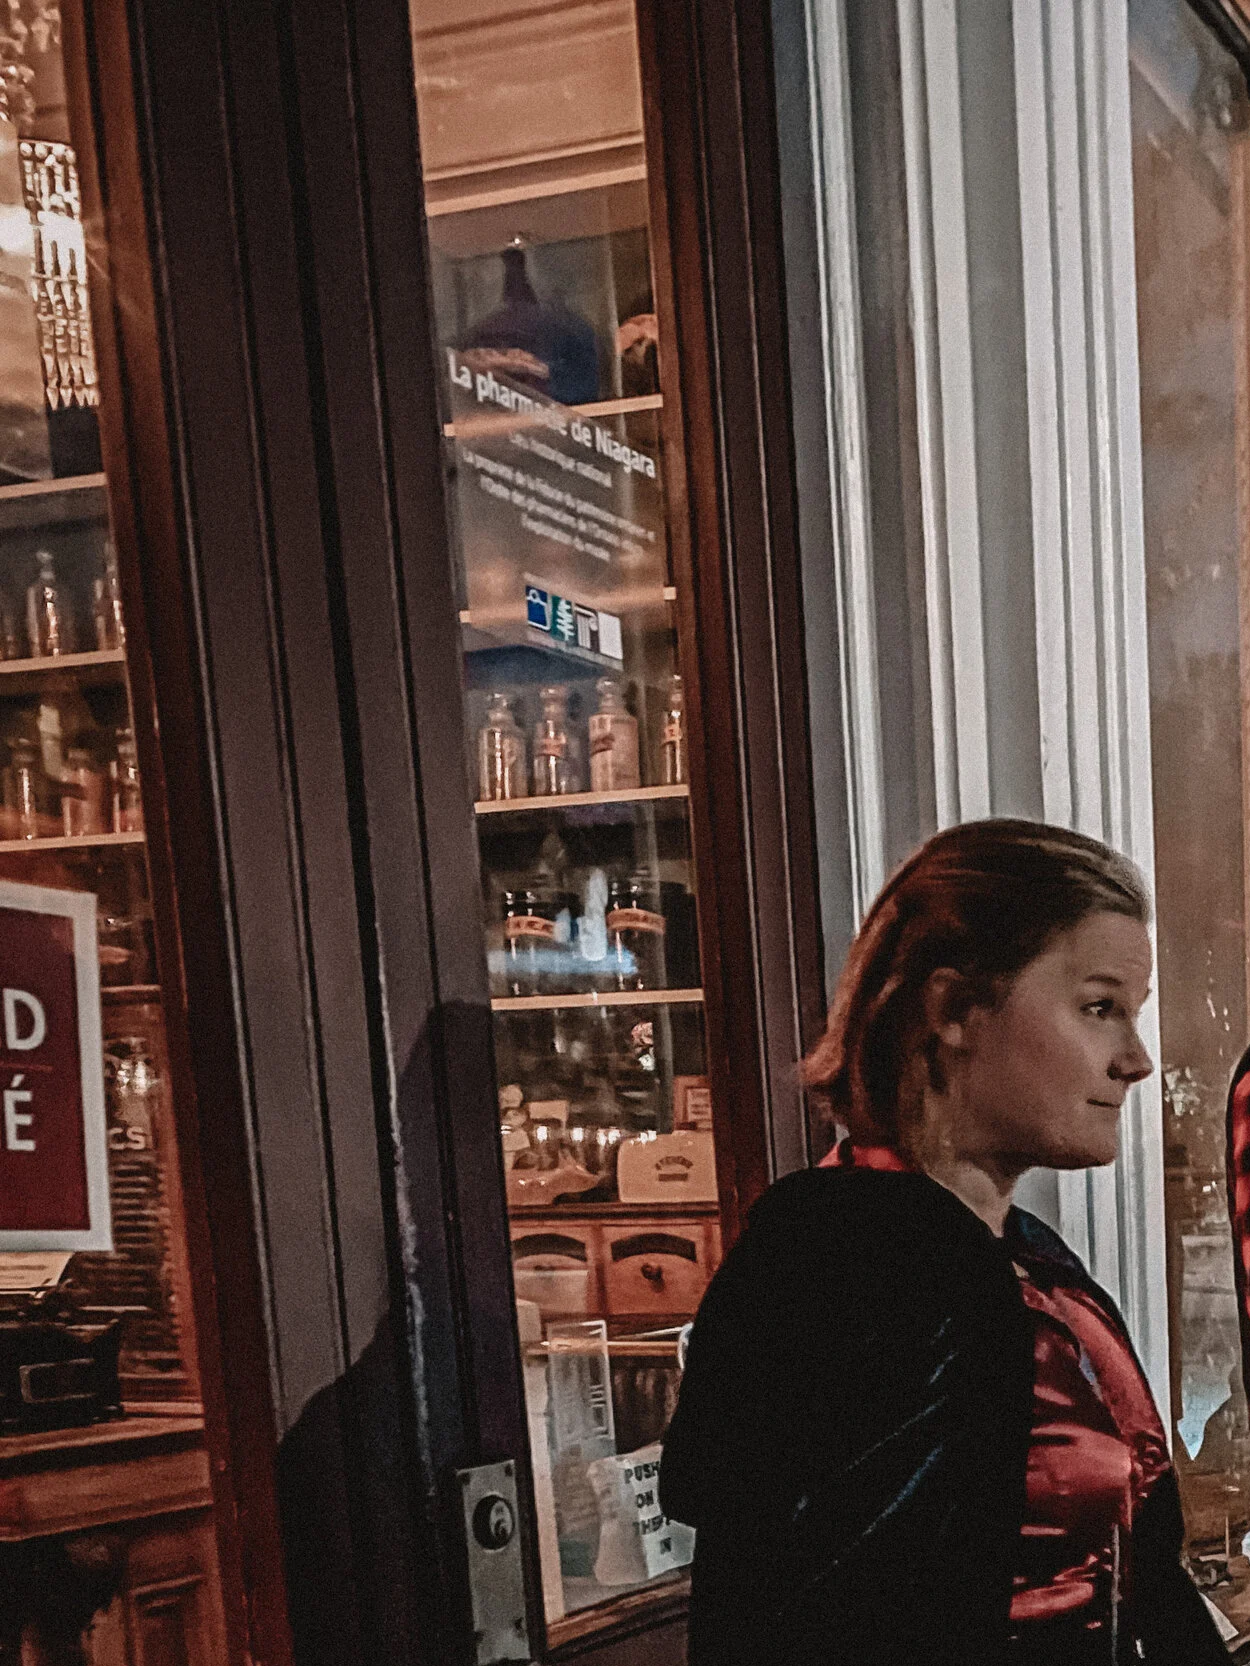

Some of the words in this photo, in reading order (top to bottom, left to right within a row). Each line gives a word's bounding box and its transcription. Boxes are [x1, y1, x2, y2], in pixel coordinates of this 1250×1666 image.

[446, 346, 473, 389] La
[571, 418, 592, 448] de
[595, 426, 656, 478] Niagara
